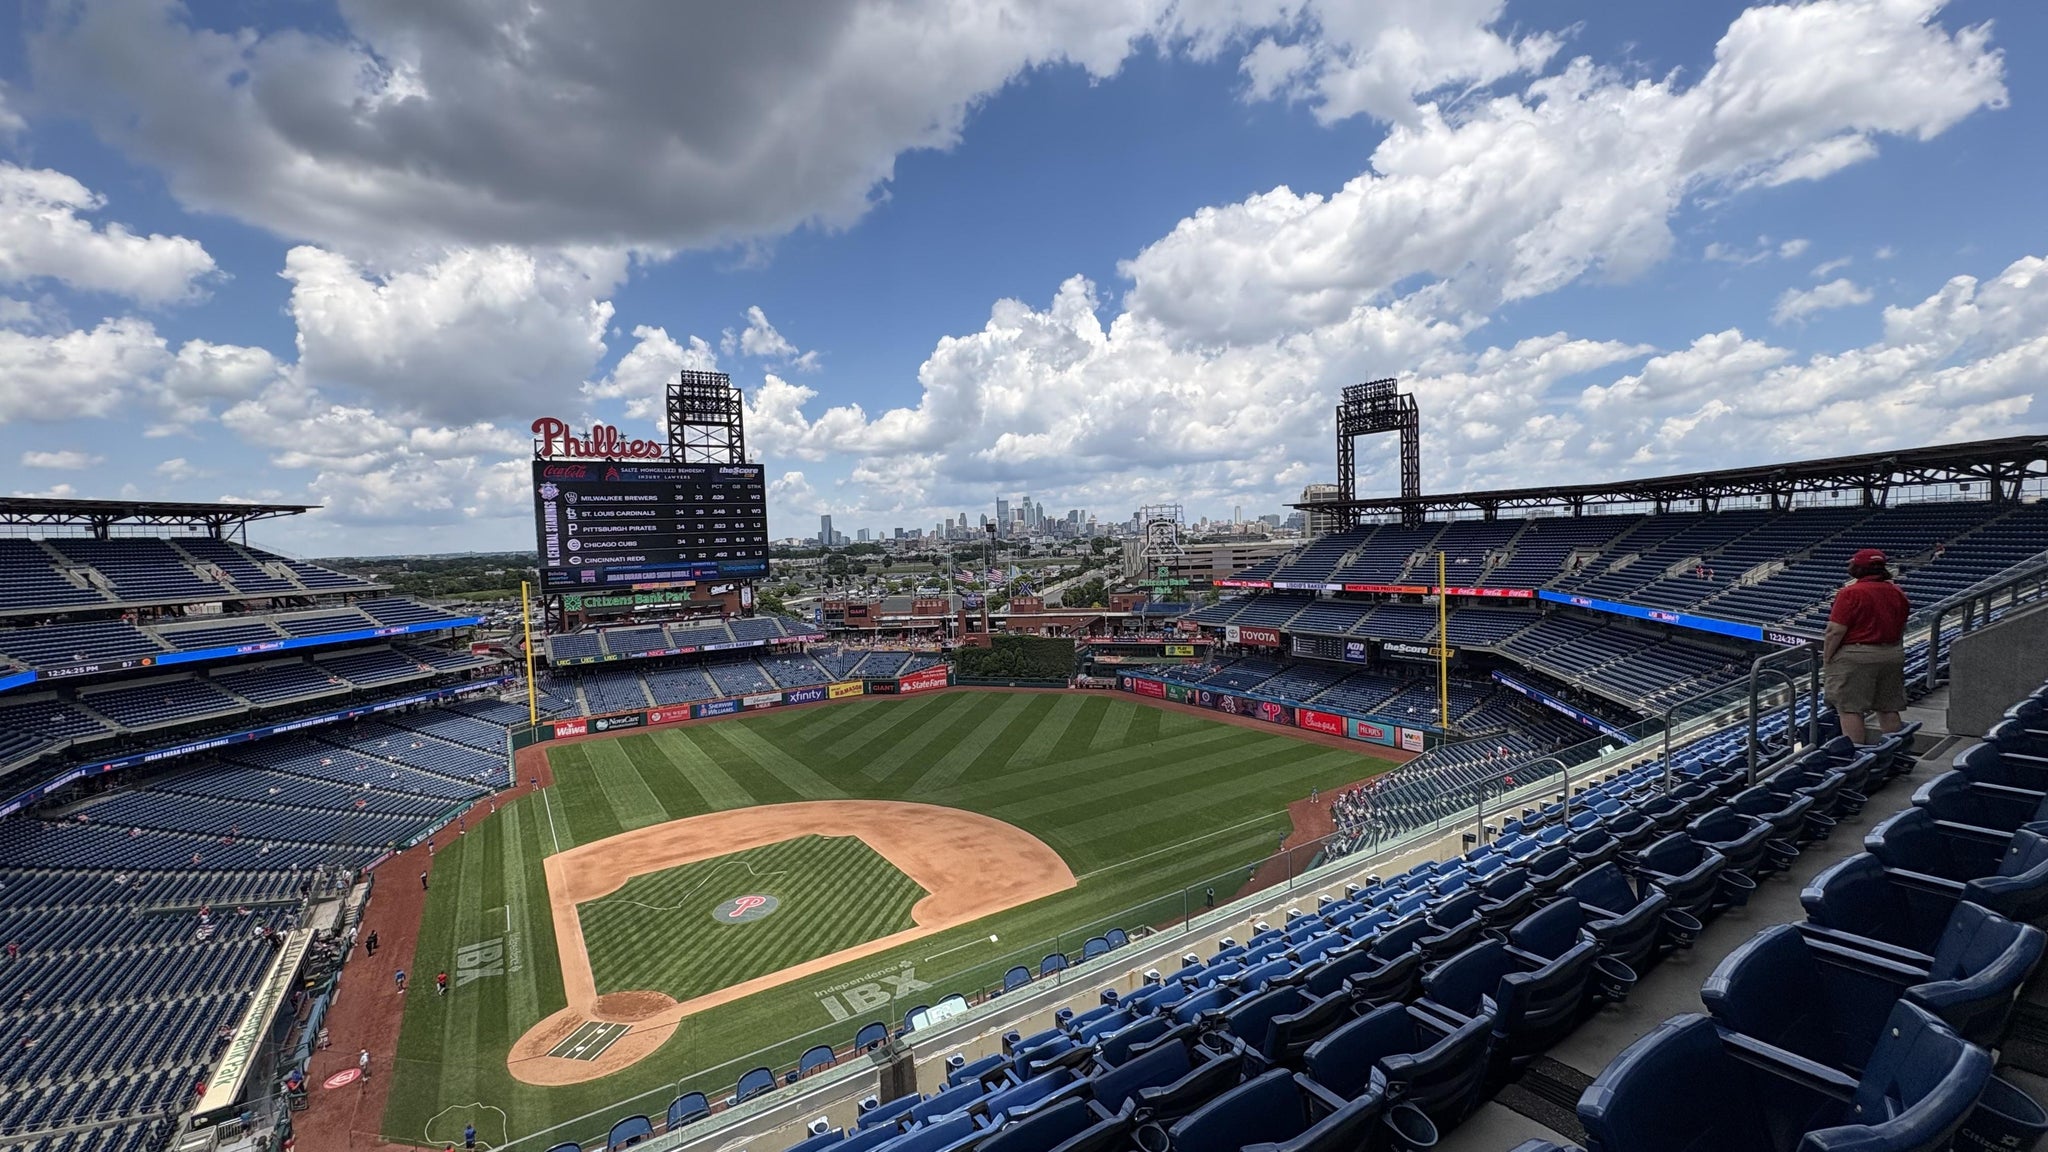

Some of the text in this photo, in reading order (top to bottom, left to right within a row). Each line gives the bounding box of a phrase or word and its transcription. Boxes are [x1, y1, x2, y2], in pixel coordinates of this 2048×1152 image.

[531, 417, 662, 458] Phillies
[543, 501, 558, 532] STANDINGS
[545, 533, 560, 558] CENTRAL
[1138, 578, 1190, 586] Citizens Bank
[583, 595, 633, 608] Citizens
[634, 592, 665, 604] Bank
[665, 590, 692, 602] Park
[1241, 630, 1276, 642] TOYOTA
[1769, 633, 1806, 645] 12:24:25 PM
[1383, 642, 1428, 654] theScore
[47, 667, 85, 677] 12:24:25
[86, 665, 99, 673] PM
[789, 689, 822, 703] xfinity
[708, 701, 734, 710] SHERWIN
[608, 716, 639, 726] NovaCare
[556, 726, 586, 737] Wawa
[456, 937, 504, 987] IBX
[814, 966, 898, 998] Independence
[820, 967, 933, 1021] IBX
[213, 1060, 247, 1089] Park
